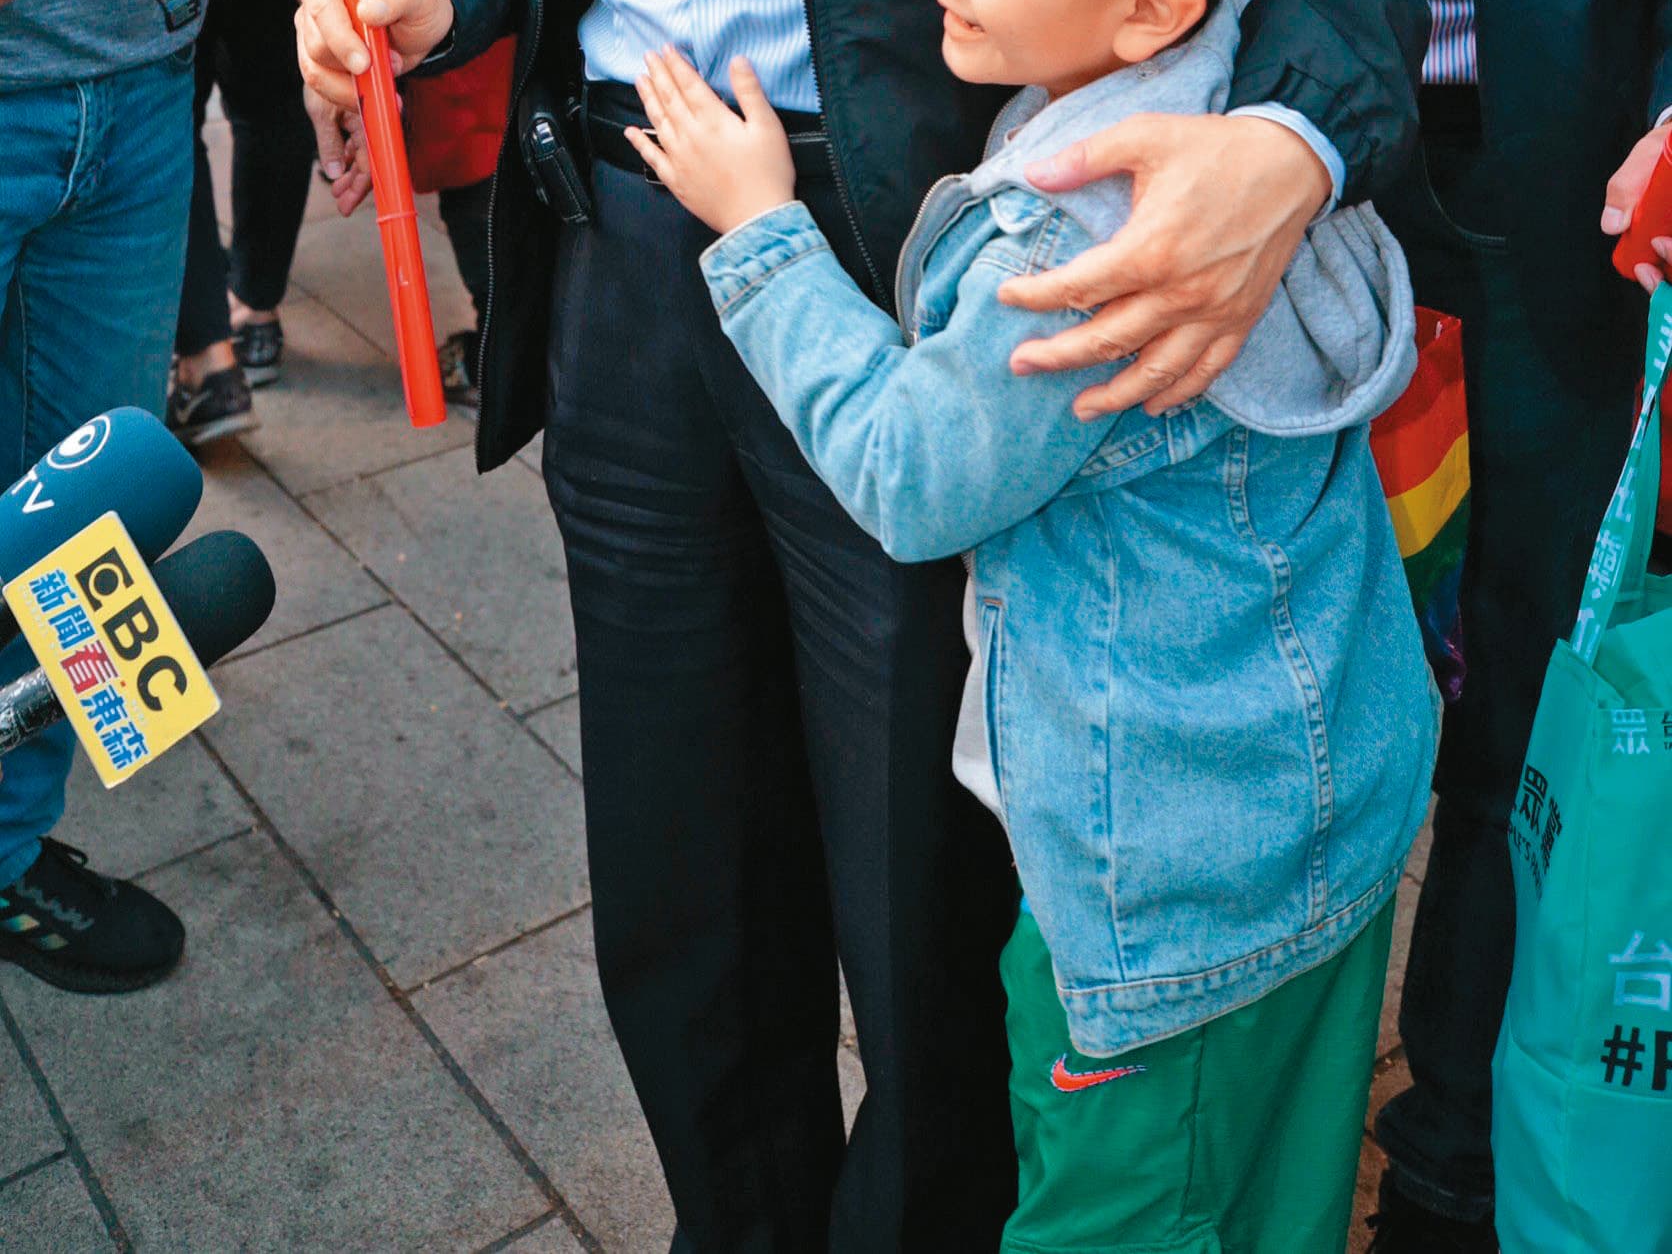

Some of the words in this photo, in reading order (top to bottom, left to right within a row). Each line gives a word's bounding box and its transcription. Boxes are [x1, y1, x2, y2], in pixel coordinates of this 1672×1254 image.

[29, 569, 148, 770] 新聞看東森
[1608, 929, 1672, 1011] 台
